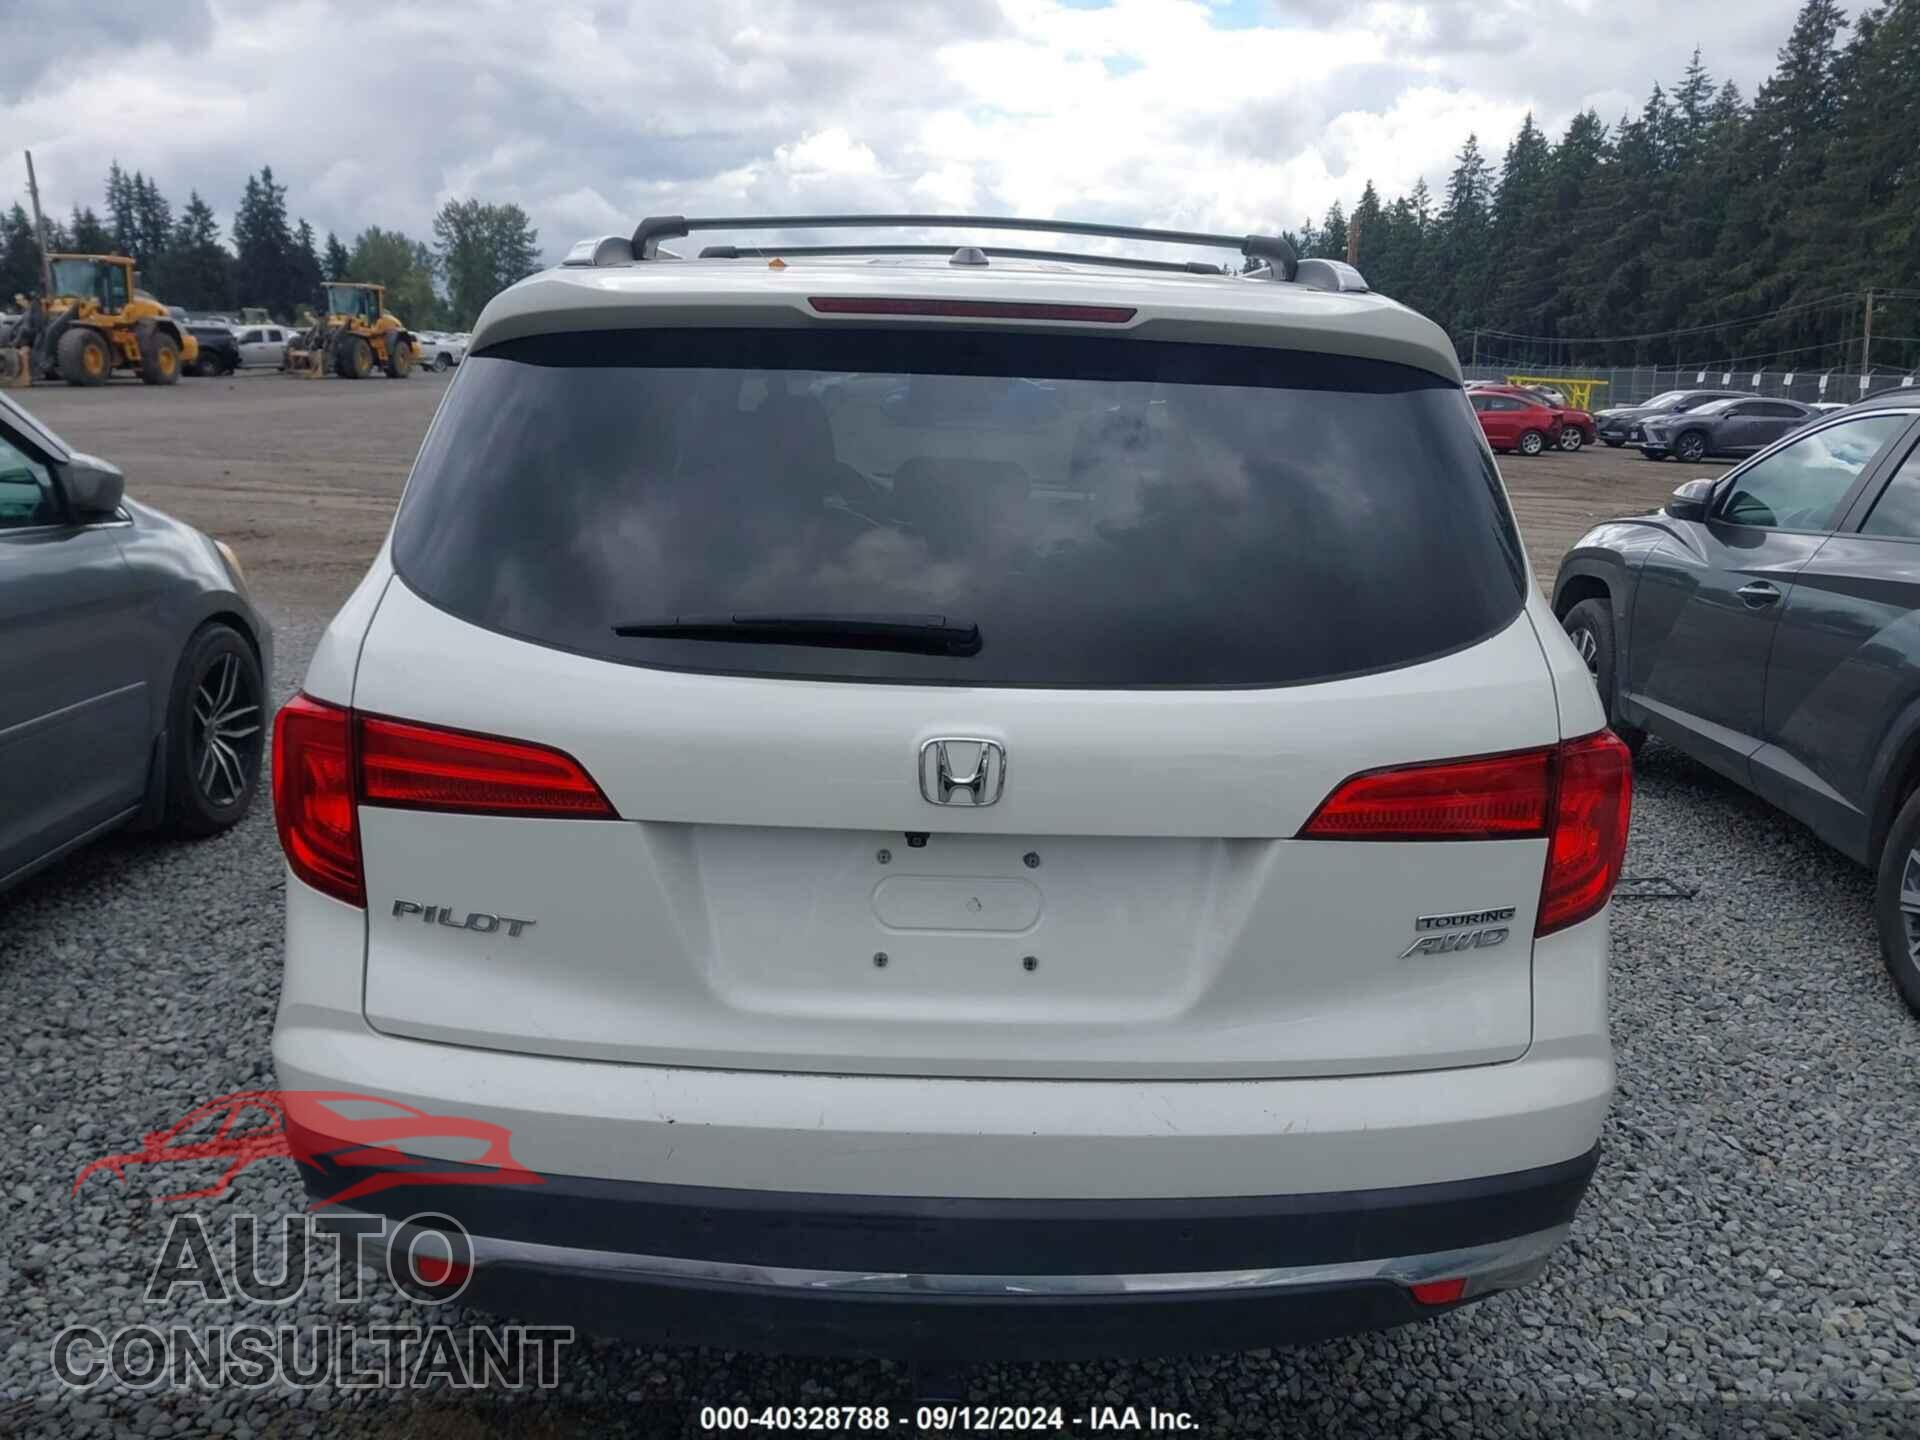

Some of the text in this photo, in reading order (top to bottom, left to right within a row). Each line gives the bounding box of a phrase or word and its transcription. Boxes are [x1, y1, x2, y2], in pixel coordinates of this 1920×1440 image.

[392, 898, 537, 938] PILOT
[1418, 908, 1515, 929] TOURING
[1400, 926, 1509, 959] AWD
